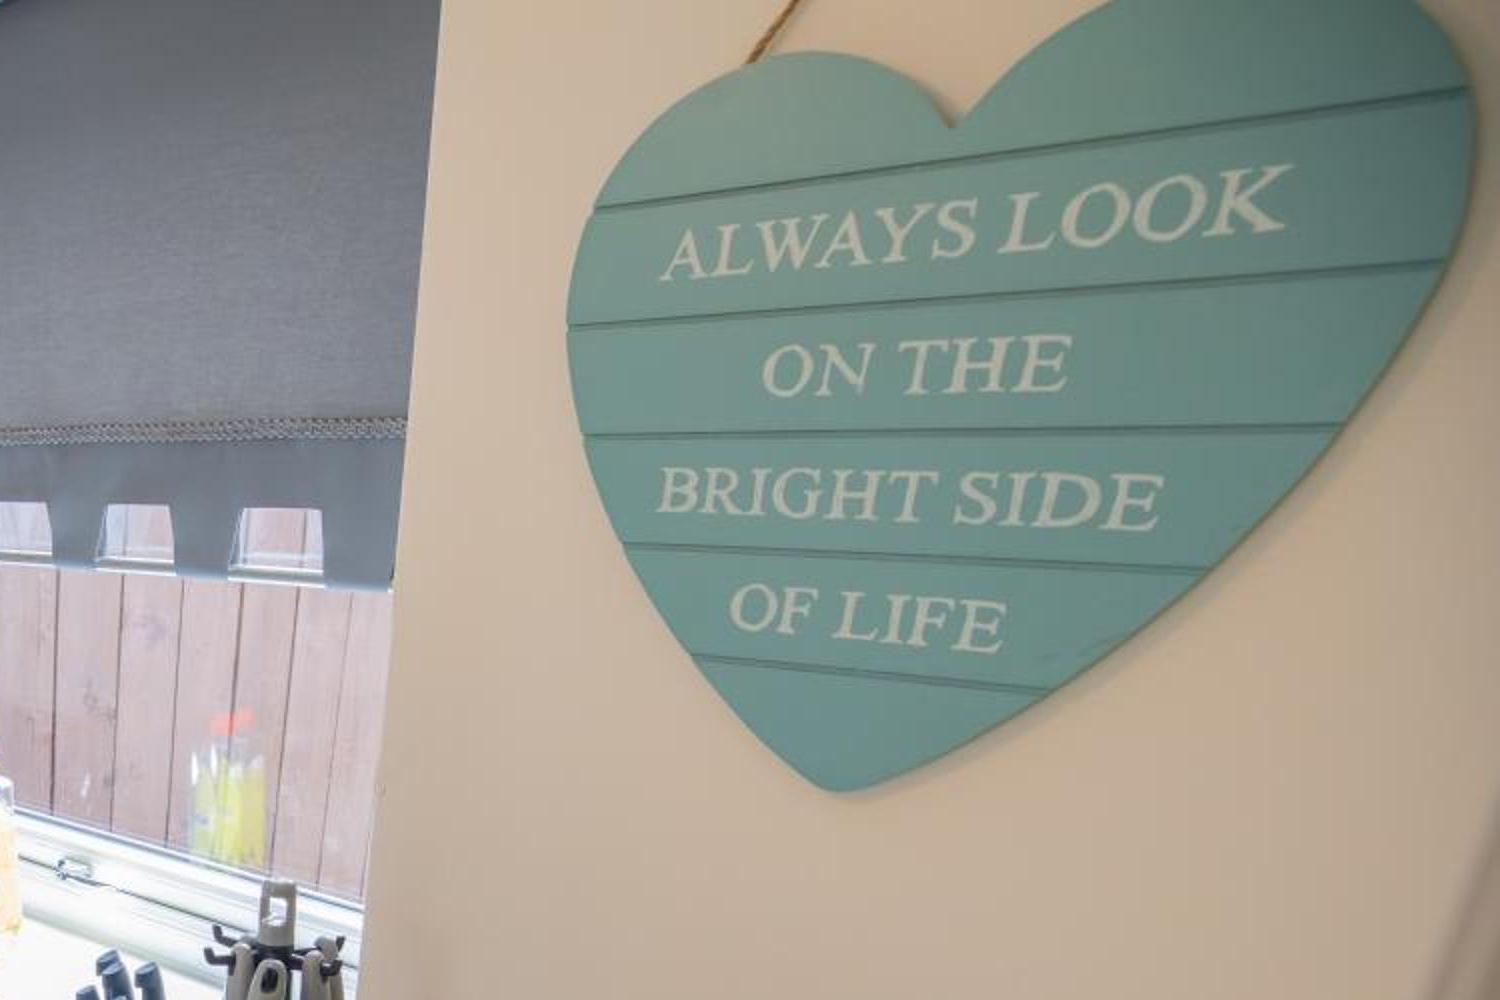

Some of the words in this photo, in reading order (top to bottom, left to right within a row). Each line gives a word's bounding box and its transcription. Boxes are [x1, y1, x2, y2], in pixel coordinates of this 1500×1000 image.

[659, 197, 978, 281] ALWAYS
[998, 163, 1293, 254] LOOK
[761, 342, 877, 398] ON
[899, 333, 1073, 395] THE
[656, 466, 940, 523] BRIGHT
[954, 471, 1165, 532] SIDE
[729, 583, 819, 635] OF
[832, 591, 1007, 655] LIFE
